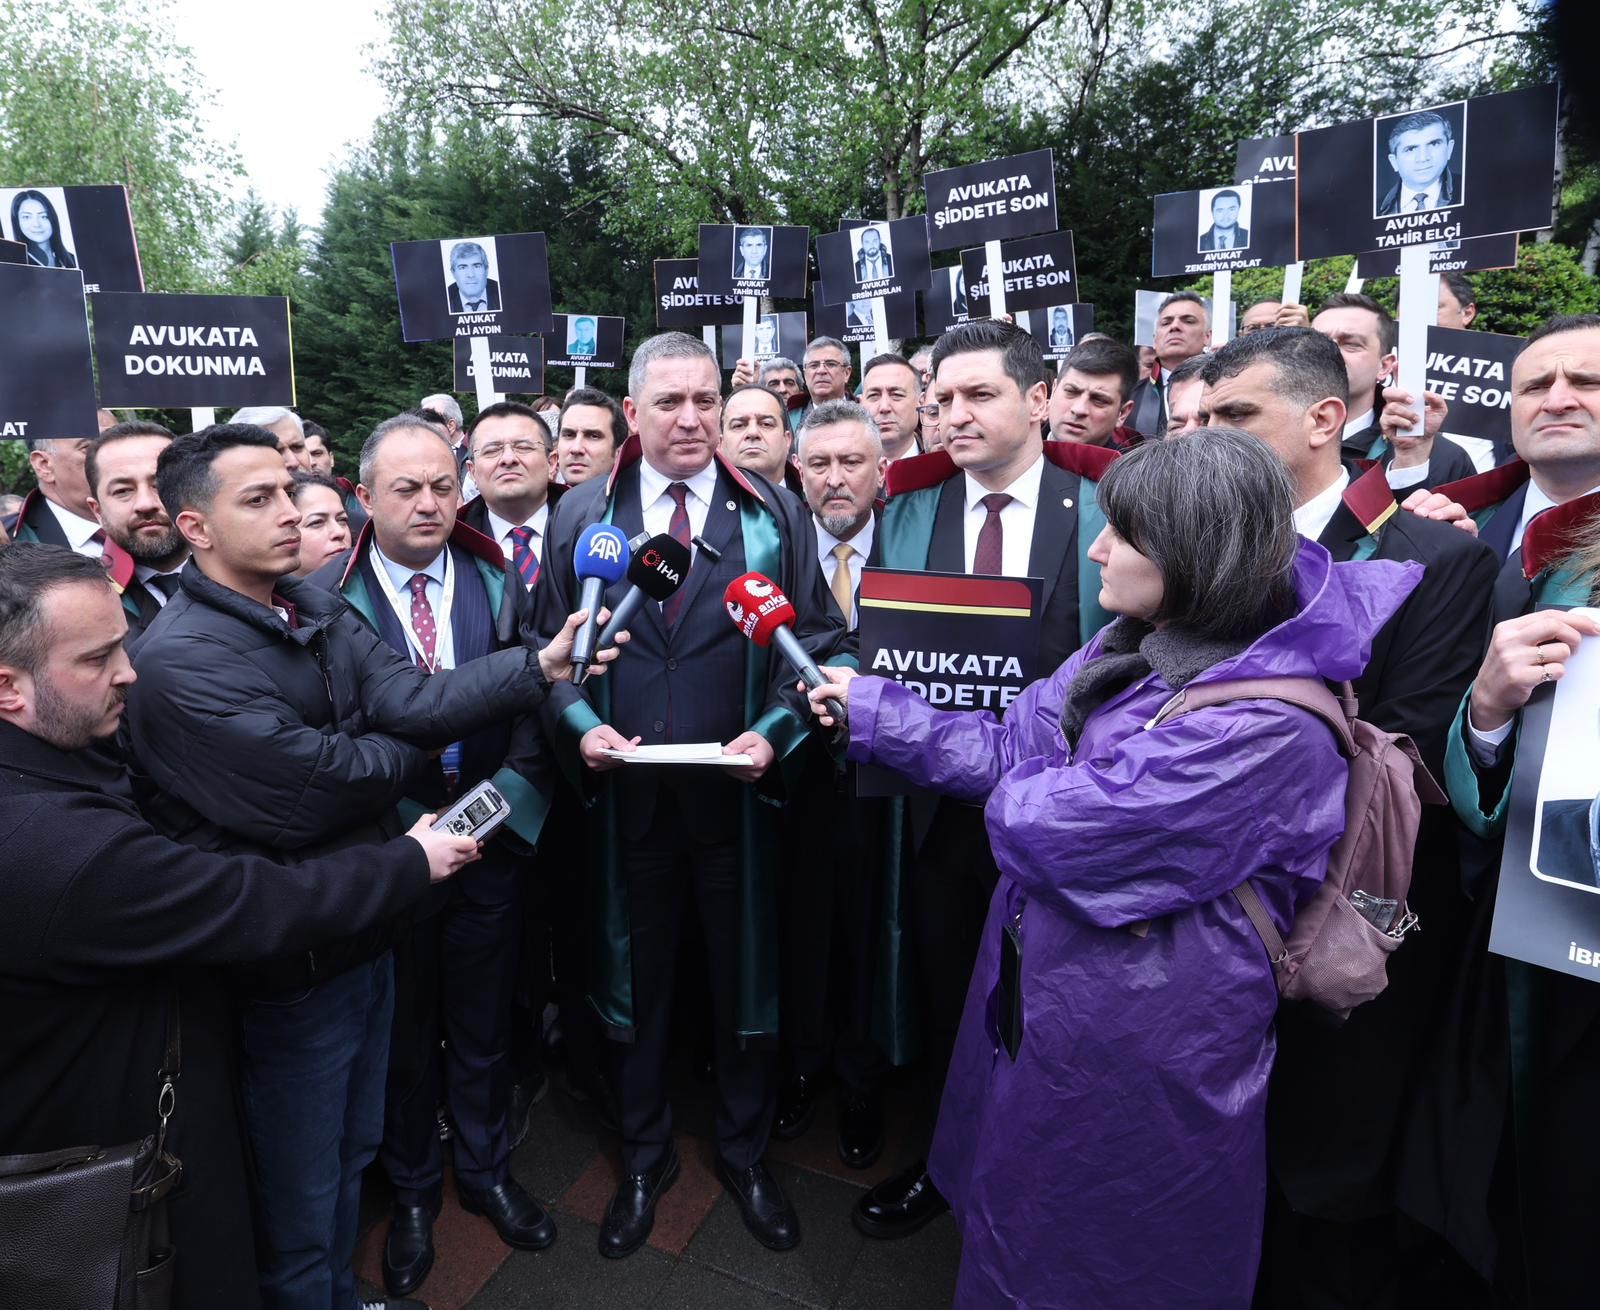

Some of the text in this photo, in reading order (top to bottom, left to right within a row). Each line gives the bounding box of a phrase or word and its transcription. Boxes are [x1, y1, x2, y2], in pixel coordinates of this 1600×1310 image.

[947, 174, 1032, 204] AVUKATA
[934, 192, 1049, 229] ŞİDDETE SON
[1385, 210, 1451, 231] AVUKAT
[1375, 222, 1461, 248] TAHİR ELÇİ
[1204, 250, 1243, 262] AVUKAT
[981, 253, 1055, 279] AUKATA
[1185, 258, 1262, 273] ZEKERİYA POLAT
[1431, 260, 1468, 272] AKSOY
[736, 280, 766, 288] AVUKAT
[861, 279, 891, 291] AVUKAT
[1036, 270, 1071, 288] SON
[661, 291, 722, 311] ŞİDDETE
[732, 287, 770, 298] TAHİR ELÇİ
[851, 285, 902, 300] ERSİN ARSLAN
[457, 313, 497, 325] AVUKAT
[129, 325, 259, 347] AVUKATA
[455, 325, 502, 336] ALİ AYDIN
[842, 334, 865, 342] ÖZGÜR
[124, 355, 266, 376] DOKUNMA
[0, 421, 29, 436] AT
[588, 532, 622, 563] AA
[656, 560, 680, 585] İHA
[758, 594, 787, 613] anka
[871, 648, 1024, 678] AVUKATA
